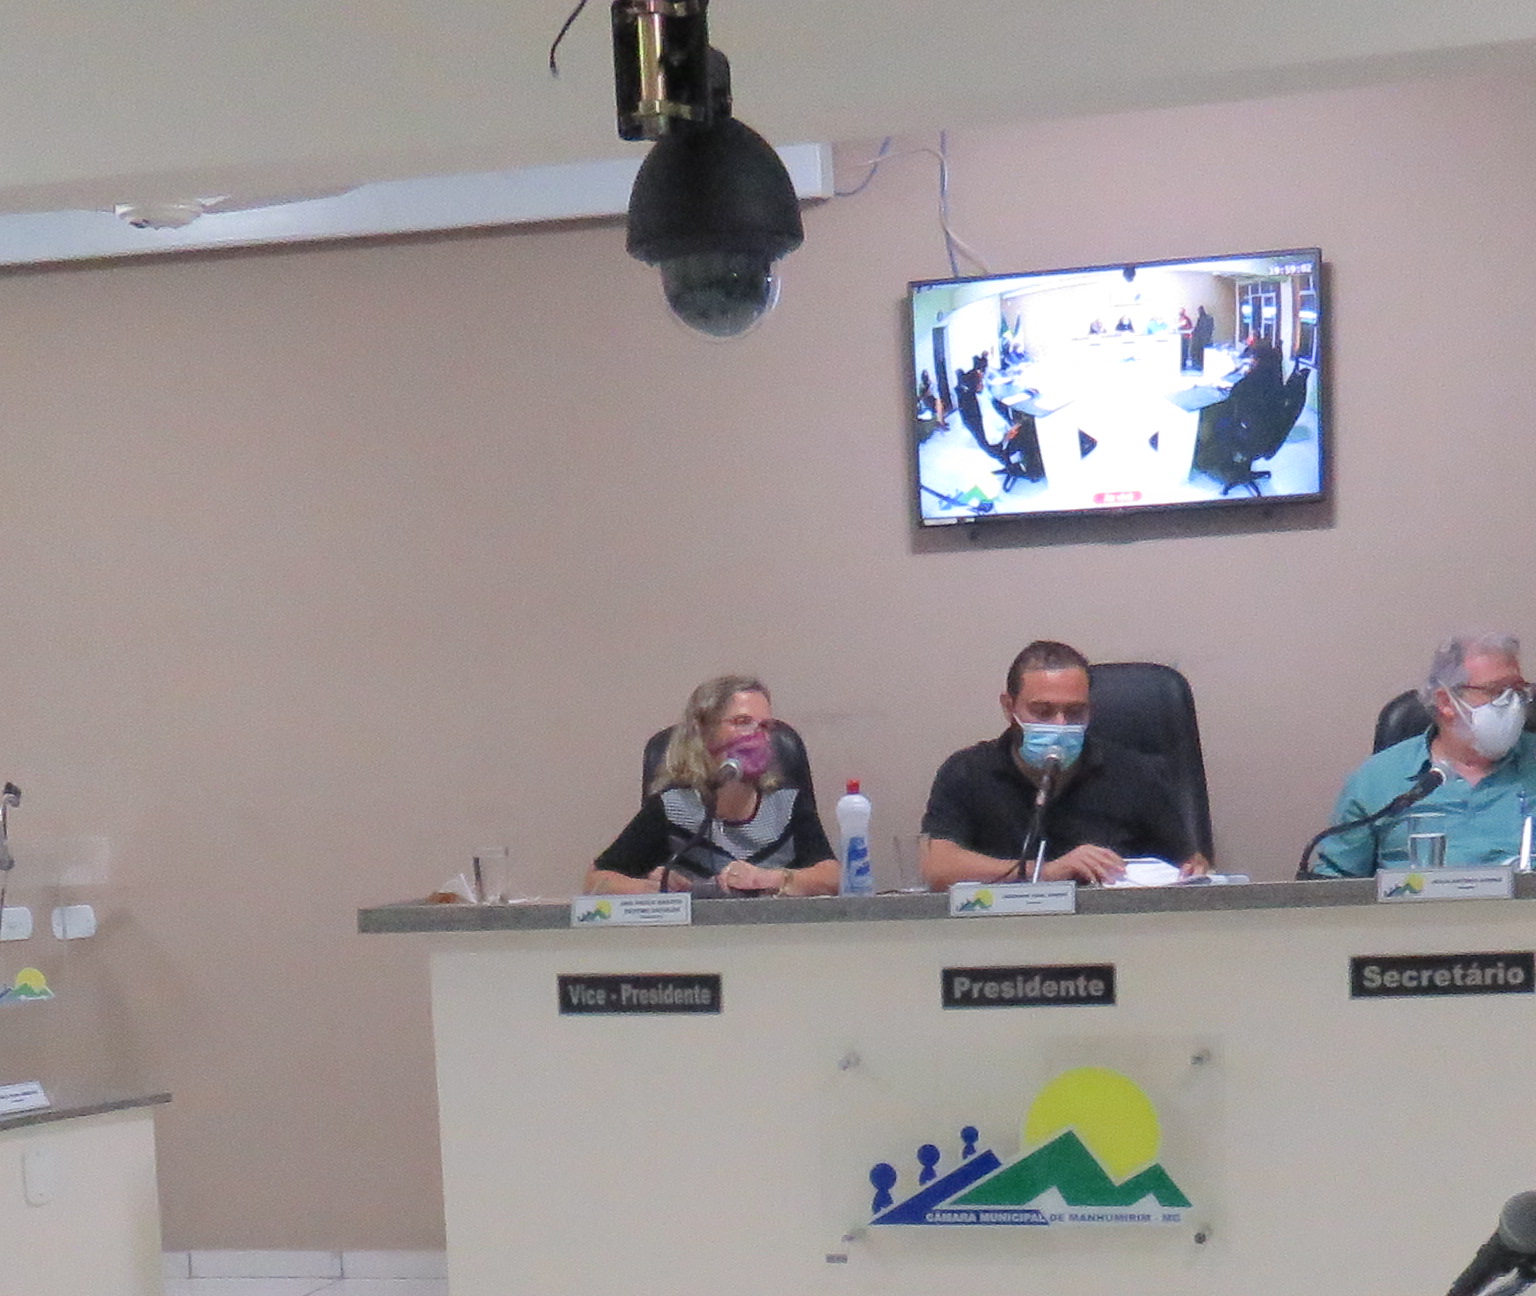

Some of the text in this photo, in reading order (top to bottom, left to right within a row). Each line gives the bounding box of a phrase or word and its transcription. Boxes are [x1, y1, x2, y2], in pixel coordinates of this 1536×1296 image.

[953, 975, 1105, 999] Presidente
[1363, 962, 1525, 989] Secretário
[568, 983, 607, 1006] Vice
[620, 983, 712, 1005] Presidente
[978, 1212, 1046, 1223] MUNICIPAL
